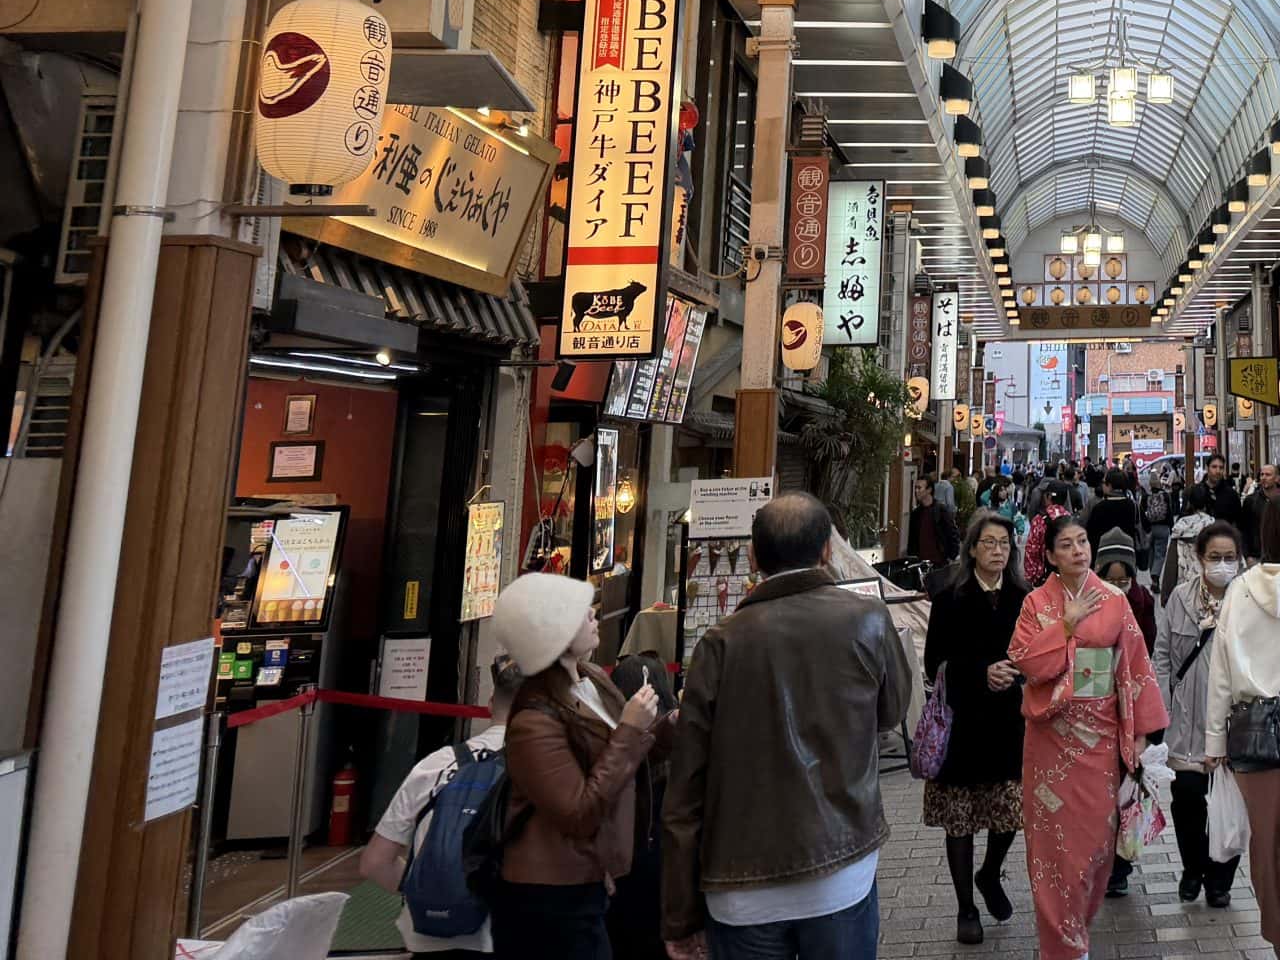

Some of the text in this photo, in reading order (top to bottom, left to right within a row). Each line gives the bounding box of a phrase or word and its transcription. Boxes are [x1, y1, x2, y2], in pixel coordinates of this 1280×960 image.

[346, 16, 390, 156] 観音通り
[424, 109, 462, 143] ITALIAN
[463, 133, 497, 162] GELATO
[585, 79, 620, 240] 神戸牛ダイア
[618, 80, 662, 238] BEEF
[386, 206, 417, 230] SINCE
[793, 166, 823, 270] 観音通り
[572, 335, 641, 350] 観音通り店
[937, 297, 954, 336] そば
